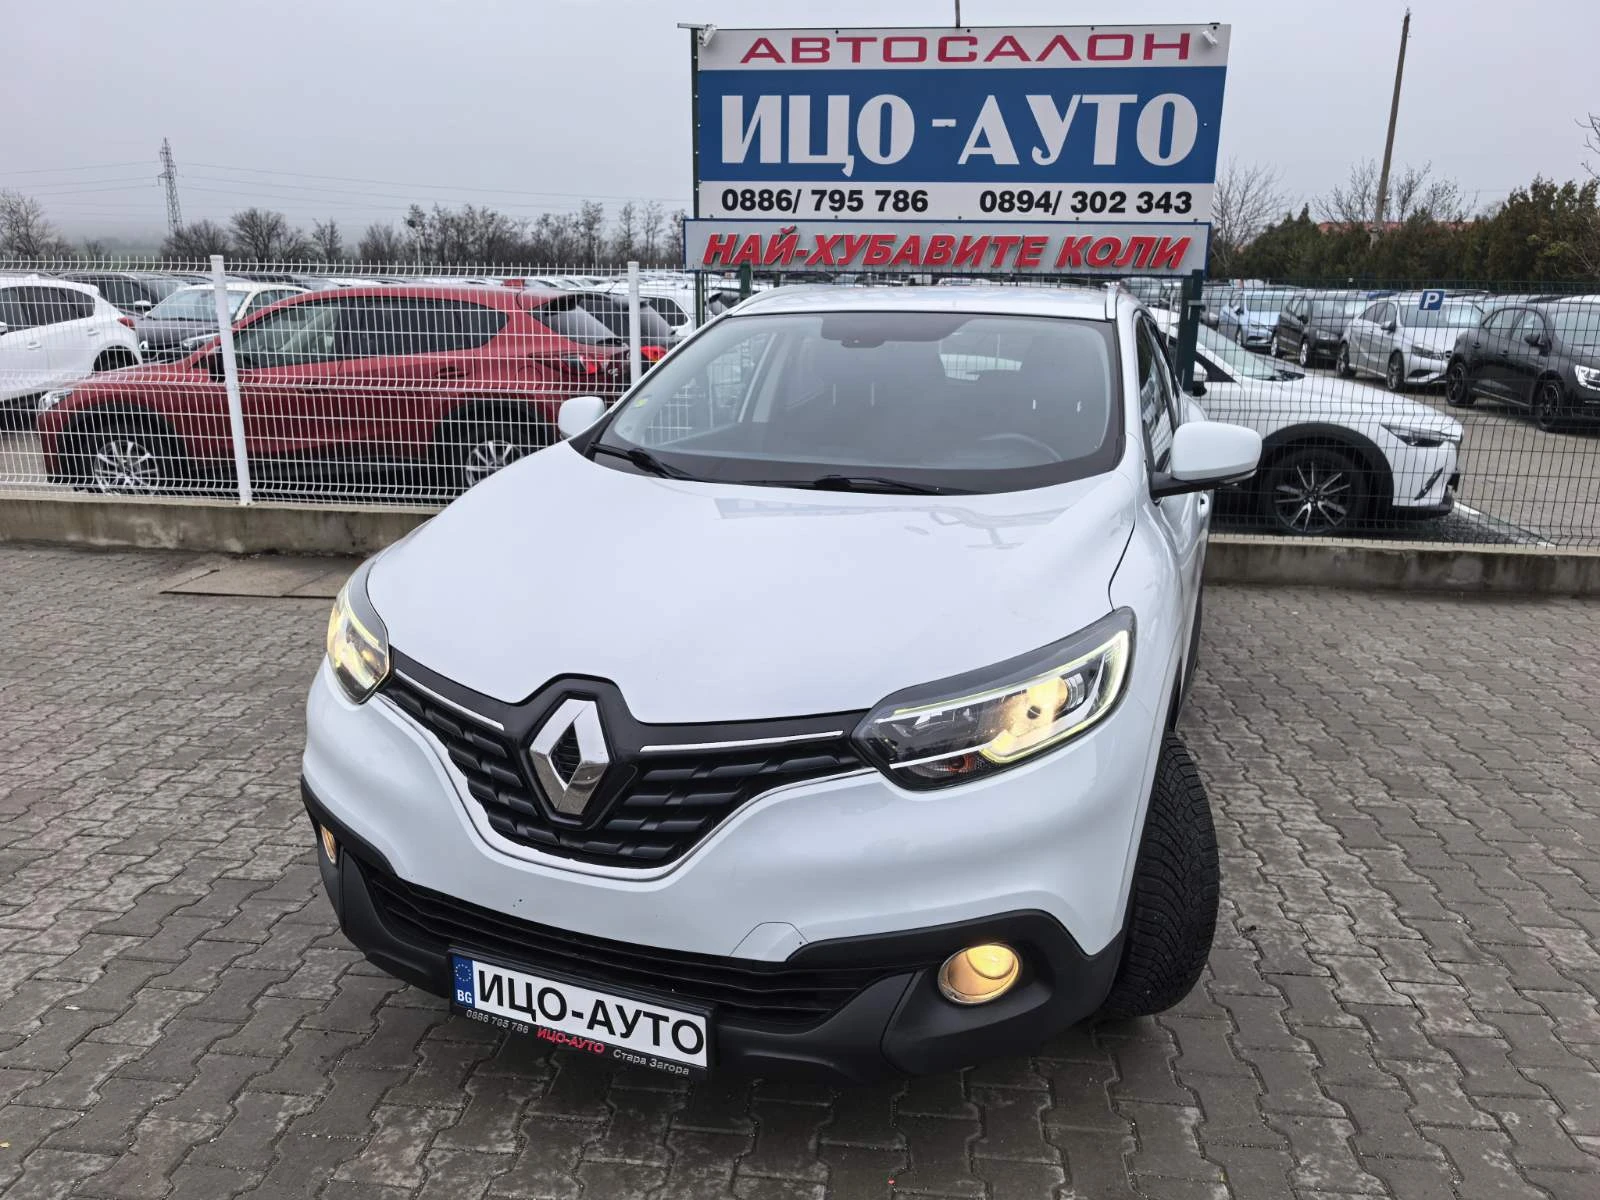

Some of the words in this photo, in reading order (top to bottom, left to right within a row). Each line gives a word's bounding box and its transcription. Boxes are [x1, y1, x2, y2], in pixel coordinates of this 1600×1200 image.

[740, 33, 1191, 64] АВТОСАЛОН
[721, 188, 802, 213] 0886/
[811, 189, 864, 212] 795
[874, 190, 929, 213] 786
[979, 190, 1063, 215] 0894/
[1070, 191, 1127, 213] 302
[1136, 191, 1192, 214] 343
[702, 225, 1049, 268] НАЙ-ХУБАВИТЕ
[1055, 235, 1192, 270] КОЛИ
[1422, 292, 1440, 309] P
[456, 989, 473, 1004] BG
[478, 969, 705, 1055] ИЦО-АУТО
[613, 1049, 647, 1065] Стара
[649, 1058, 690, 1075] Загора
